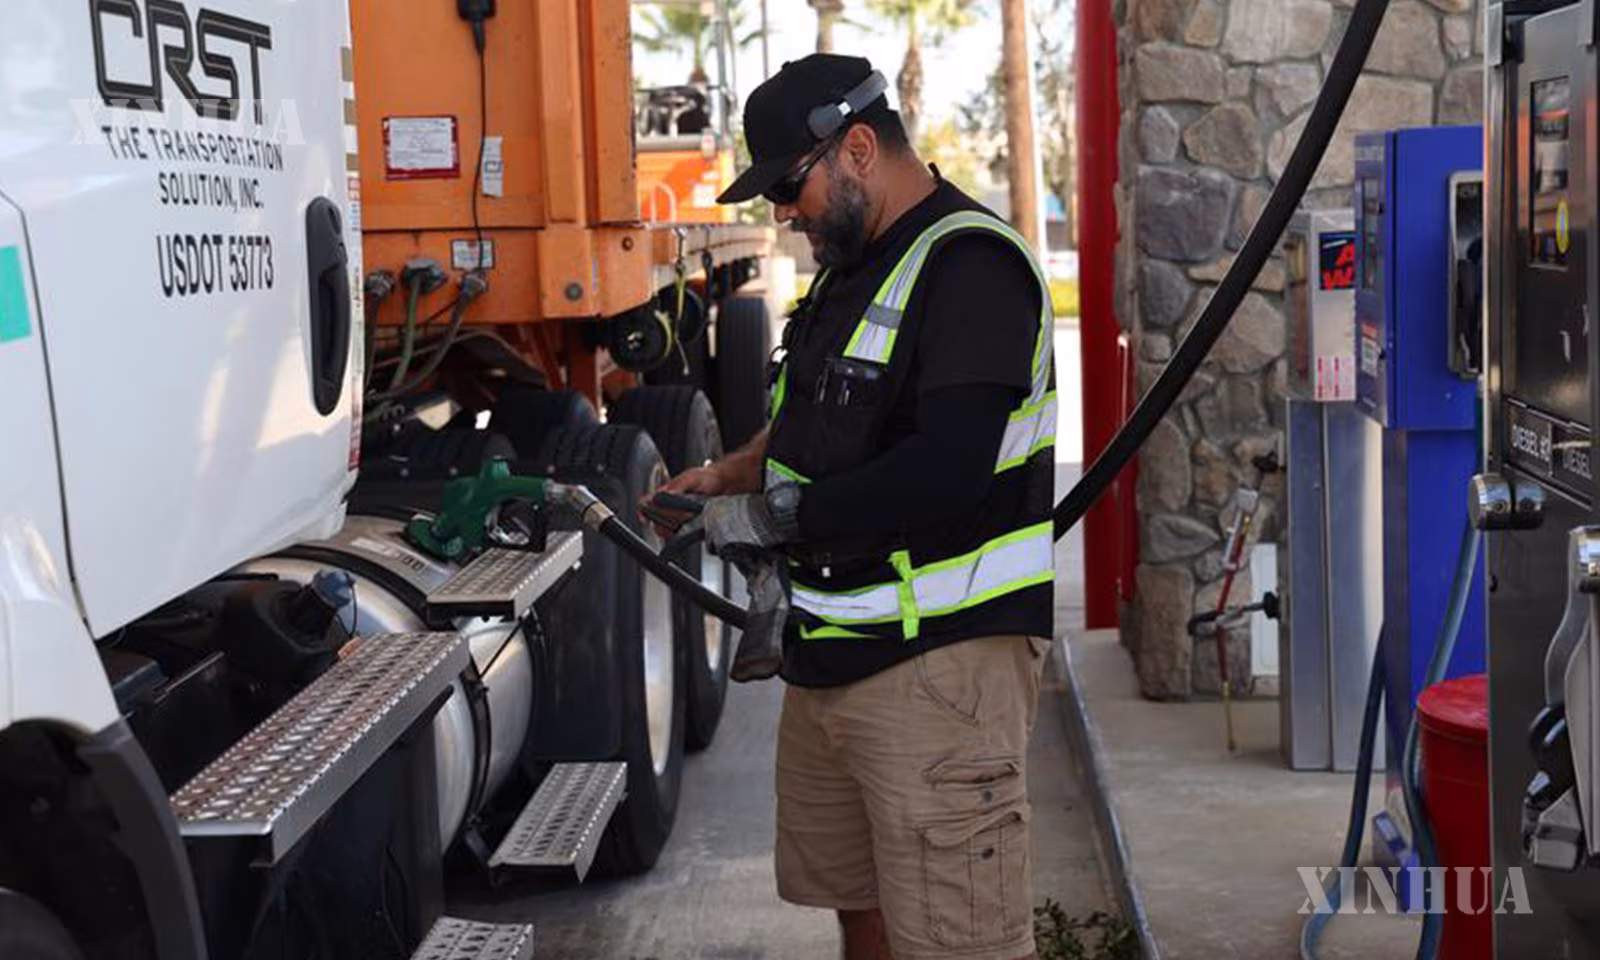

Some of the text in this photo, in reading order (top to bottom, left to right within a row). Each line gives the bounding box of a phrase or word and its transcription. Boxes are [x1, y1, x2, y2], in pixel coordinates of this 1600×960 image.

[90, 0, 272, 125] CRST
[102, 126, 284, 171] THE TRANSPORTATION
[240, 179, 265, 209] INC.
[156, 234, 275, 298] USDOT 53773
[1511, 423, 1539, 457] DIESEL
